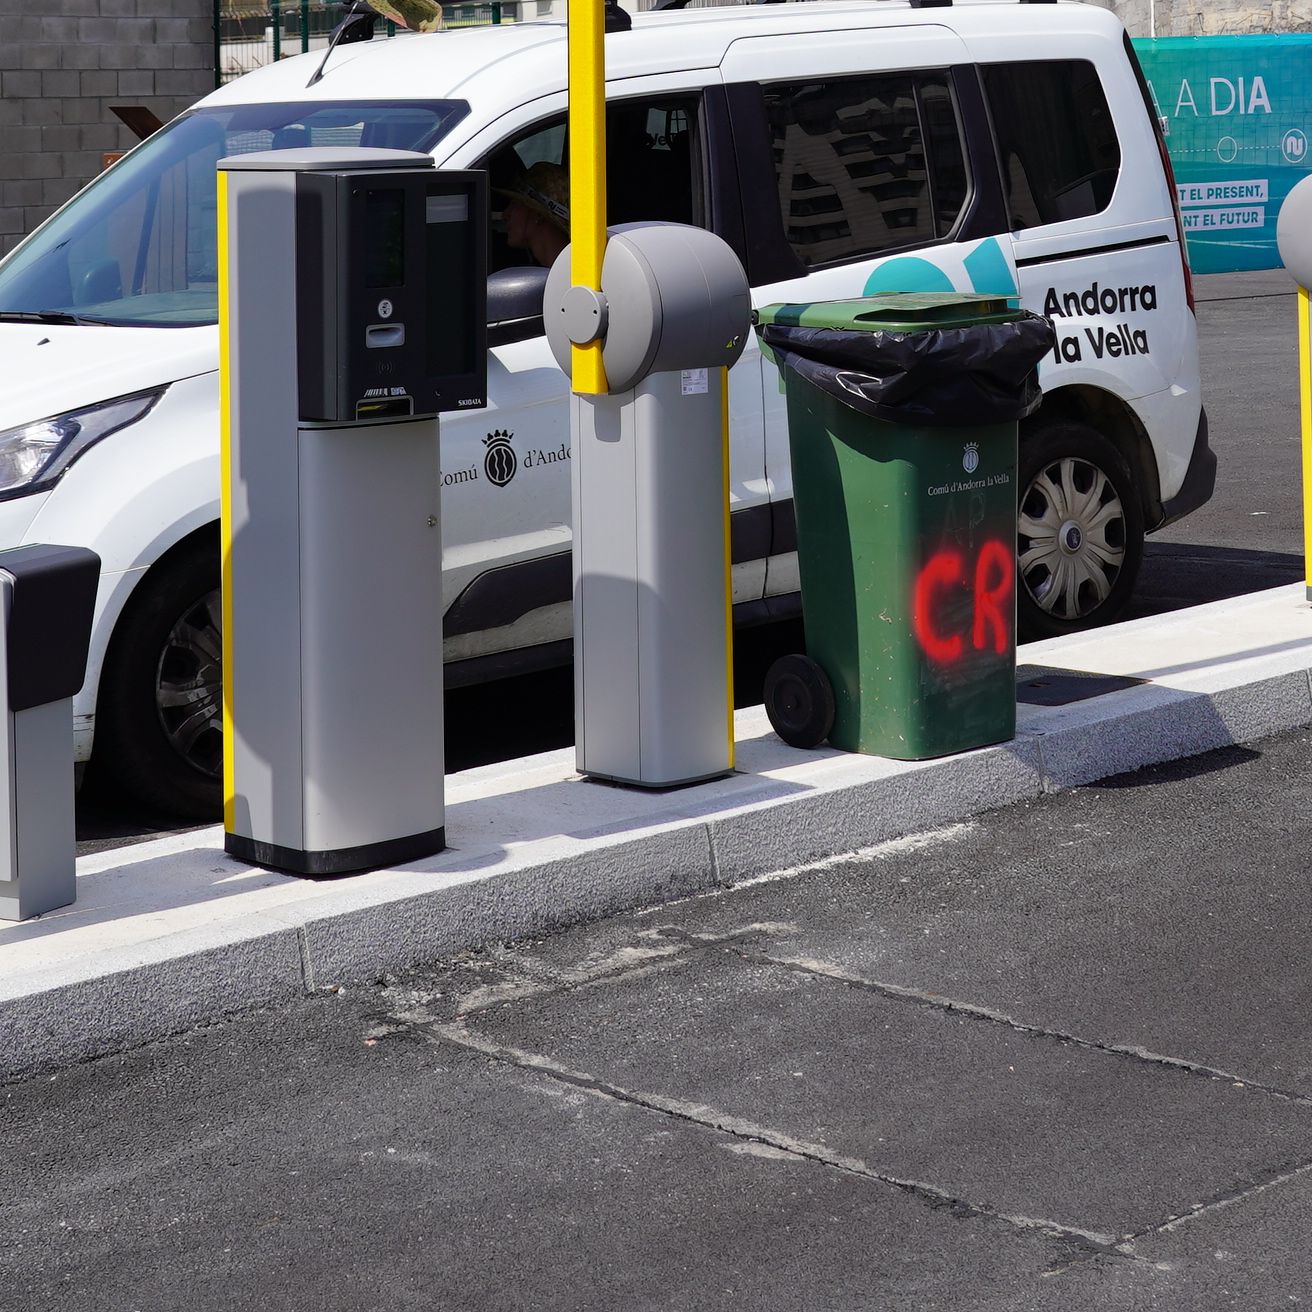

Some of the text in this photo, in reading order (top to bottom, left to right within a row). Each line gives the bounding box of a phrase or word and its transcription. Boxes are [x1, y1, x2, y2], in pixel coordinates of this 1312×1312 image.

[1174, 78, 1199, 118] A
[1209, 75, 1272, 116] DIA
[1190, 188, 1203, 201] EL
[1206, 184, 1264, 200] PRESENT,
[1203, 214, 1216, 226] EL
[1219, 211, 1259, 225] FUTUR
[1044, 281, 1157, 318] Andorra
[1053, 321, 1150, 364] la Vella
[457, 398, 482, 407] SKIDATA
[928, 483, 949, 495] Comú
[950, 479, 986, 492] d'Andorra
[993, 473, 1009, 484] Vella
[914, 539, 1014, 663] CR
